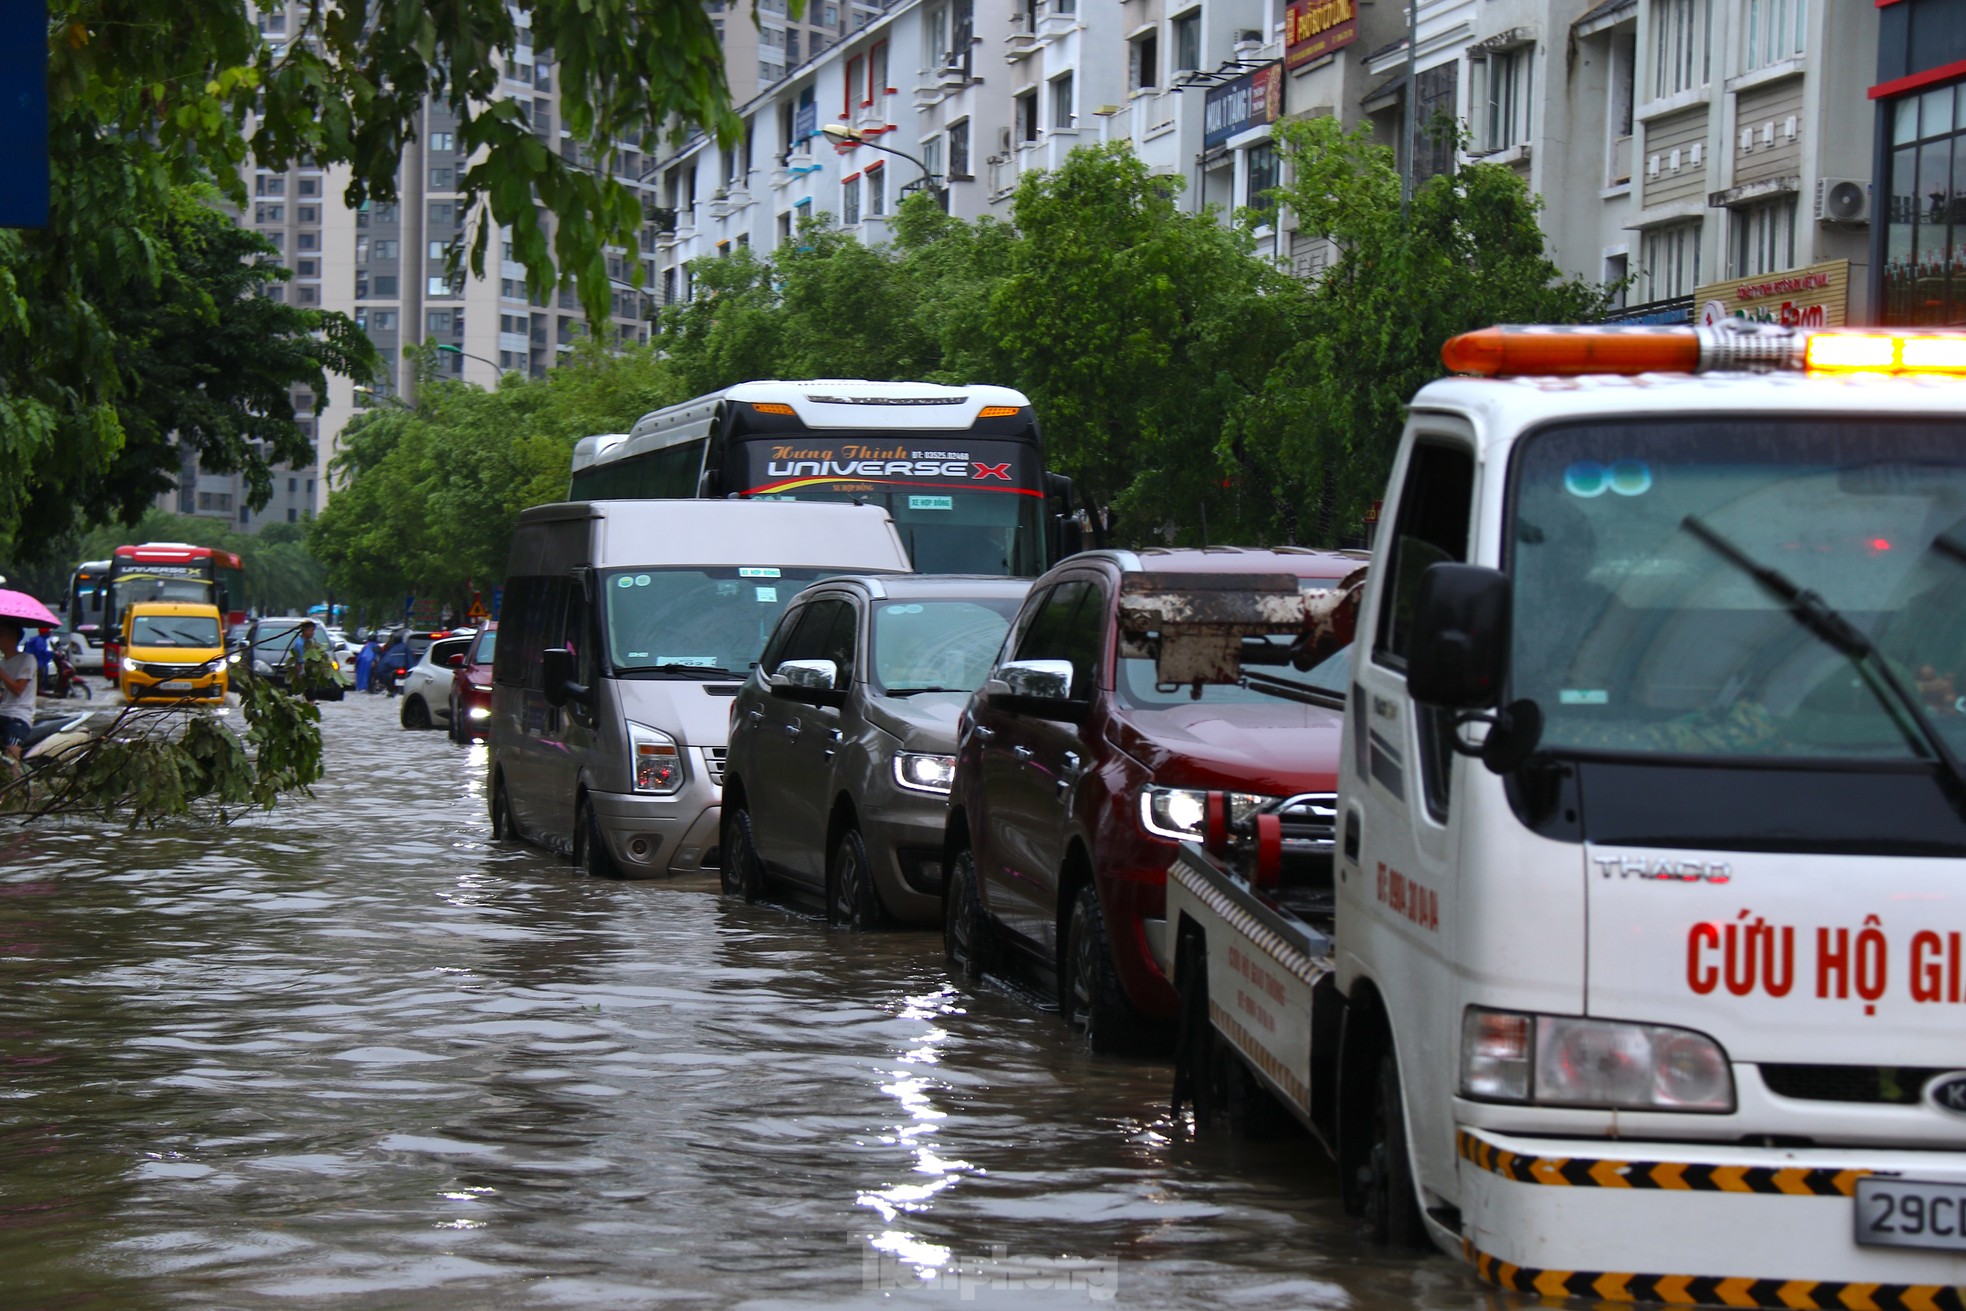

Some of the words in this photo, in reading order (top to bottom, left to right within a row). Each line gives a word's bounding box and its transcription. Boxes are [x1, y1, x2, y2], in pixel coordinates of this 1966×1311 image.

[841, 445, 908, 461] Thịnh
[767, 461, 969, 477] UNIVERSE
[971, 462, 1013, 480] X
[1593, 855, 1732, 884] THACO
[1686, 908, 1795, 998] CỨU
[1815, 913, 1888, 1017] HỘ
[1909, 929, 1966, 1004] GI
[1870, 1193, 1966, 1237] 29C
